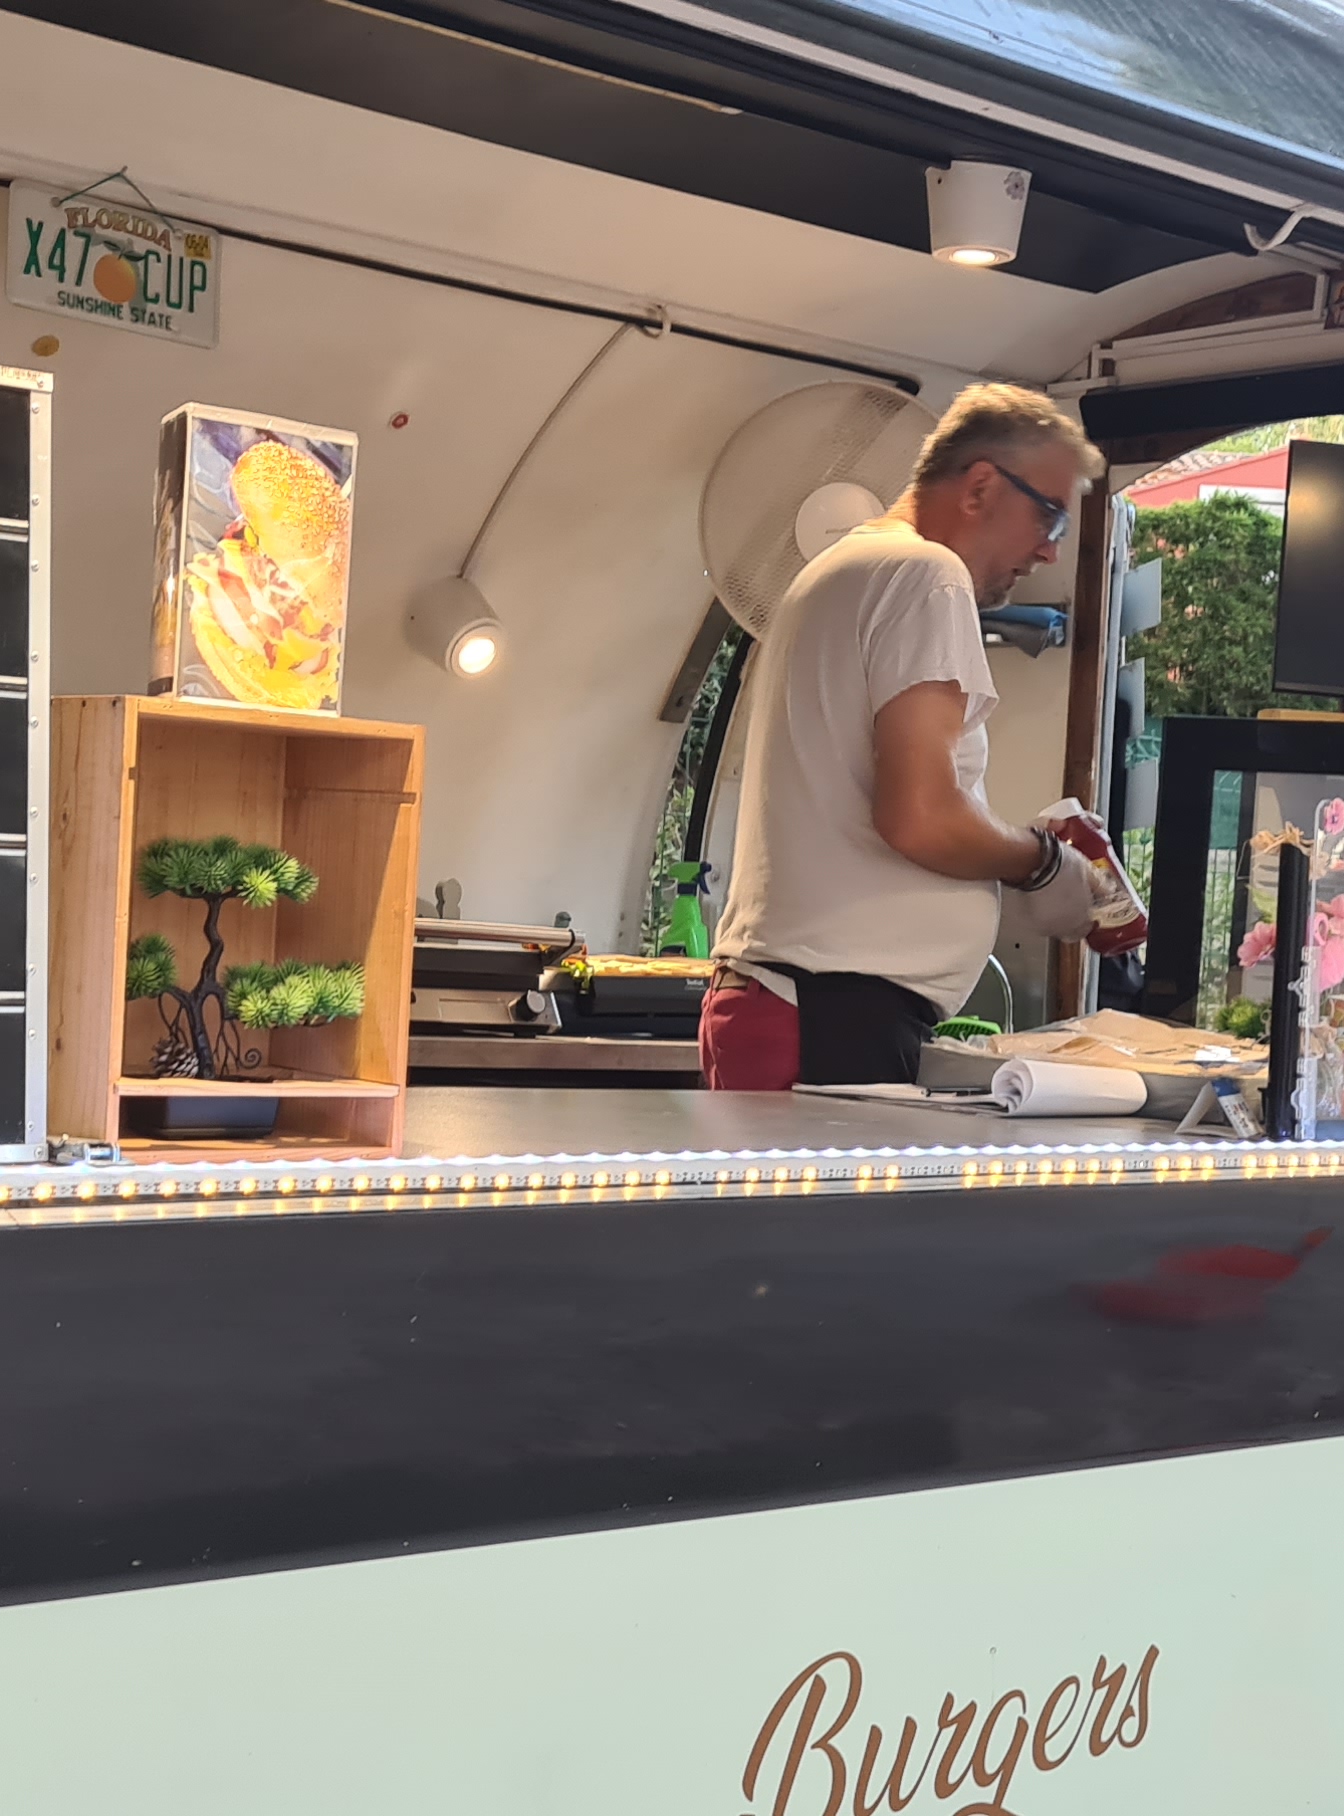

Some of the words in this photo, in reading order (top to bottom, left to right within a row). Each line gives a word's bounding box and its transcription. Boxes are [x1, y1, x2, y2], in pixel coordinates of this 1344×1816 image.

[64, 206, 173, 252] FLORIDA
[22, 217, 93, 287] X47
[142, 249, 207, 313] CUP
[57, 290, 124, 321] SUNSHINE
[129, 306, 173, 332] STATE
[741, 1643, 1160, 1816] Burgers
